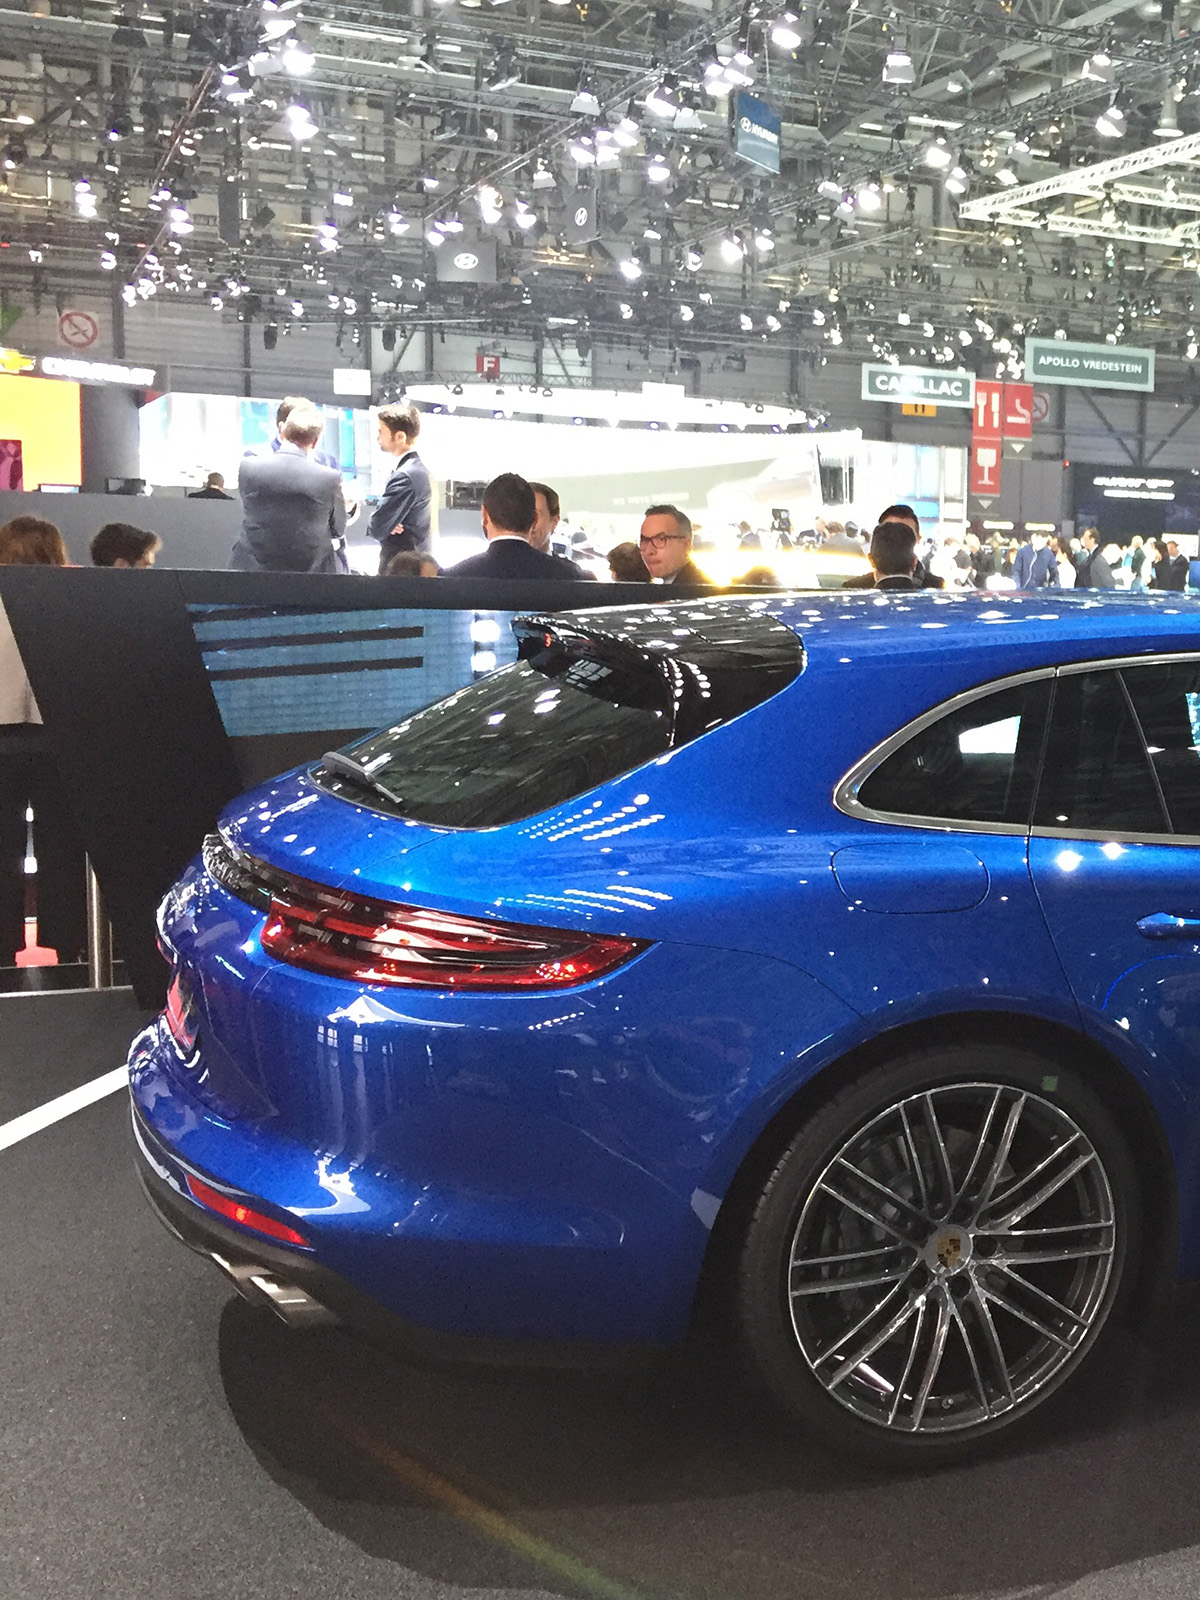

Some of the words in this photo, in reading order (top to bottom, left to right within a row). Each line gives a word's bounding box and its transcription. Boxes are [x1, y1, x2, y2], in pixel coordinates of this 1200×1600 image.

[483, 357, 495, 372] F
[1039, 355, 1080, 368] APOLLO
[1083, 360, 1143, 374] VREDESTEIN
[875, 375, 962, 397] CAILLAC
